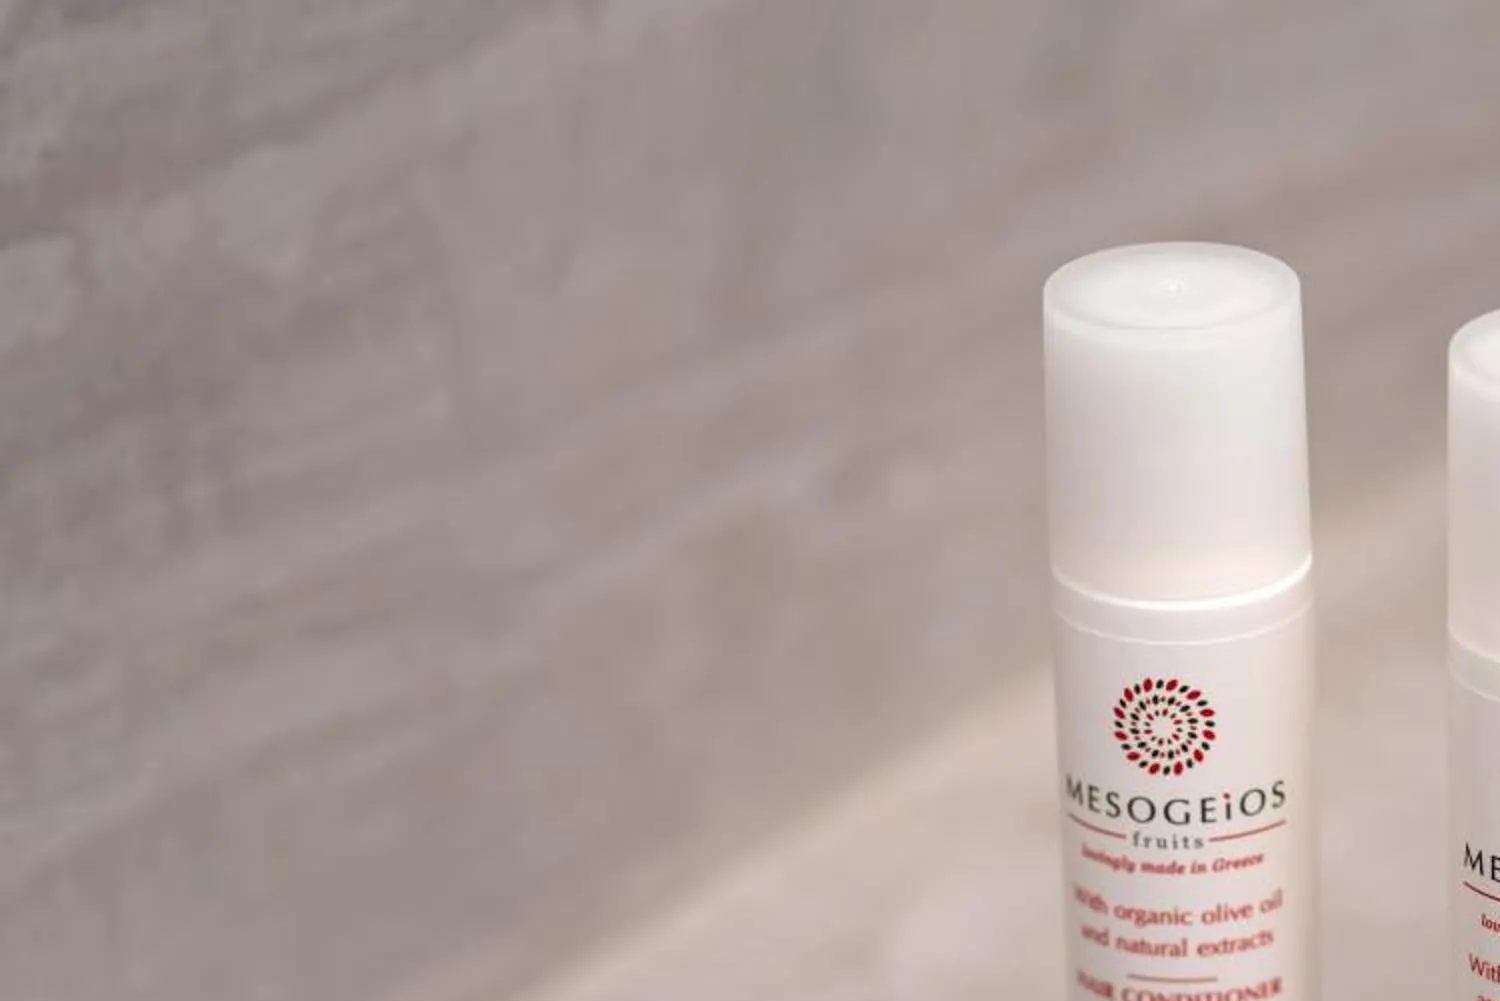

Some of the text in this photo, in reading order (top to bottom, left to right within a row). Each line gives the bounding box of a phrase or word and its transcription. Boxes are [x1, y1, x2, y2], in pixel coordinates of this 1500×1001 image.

[1065, 776, 1286, 826] MESOGEiOS
[1132, 832, 1204, 850] fruits
[1140, 859, 1185, 874] made
[1190, 859, 1207, 874] in
[1113, 903, 1193, 928] organic
[1201, 903, 1253, 926] olive
[1260, 888, 1283, 914] oil
[1115, 936, 1188, 957] natural
[1196, 929, 1274, 958] extracts
